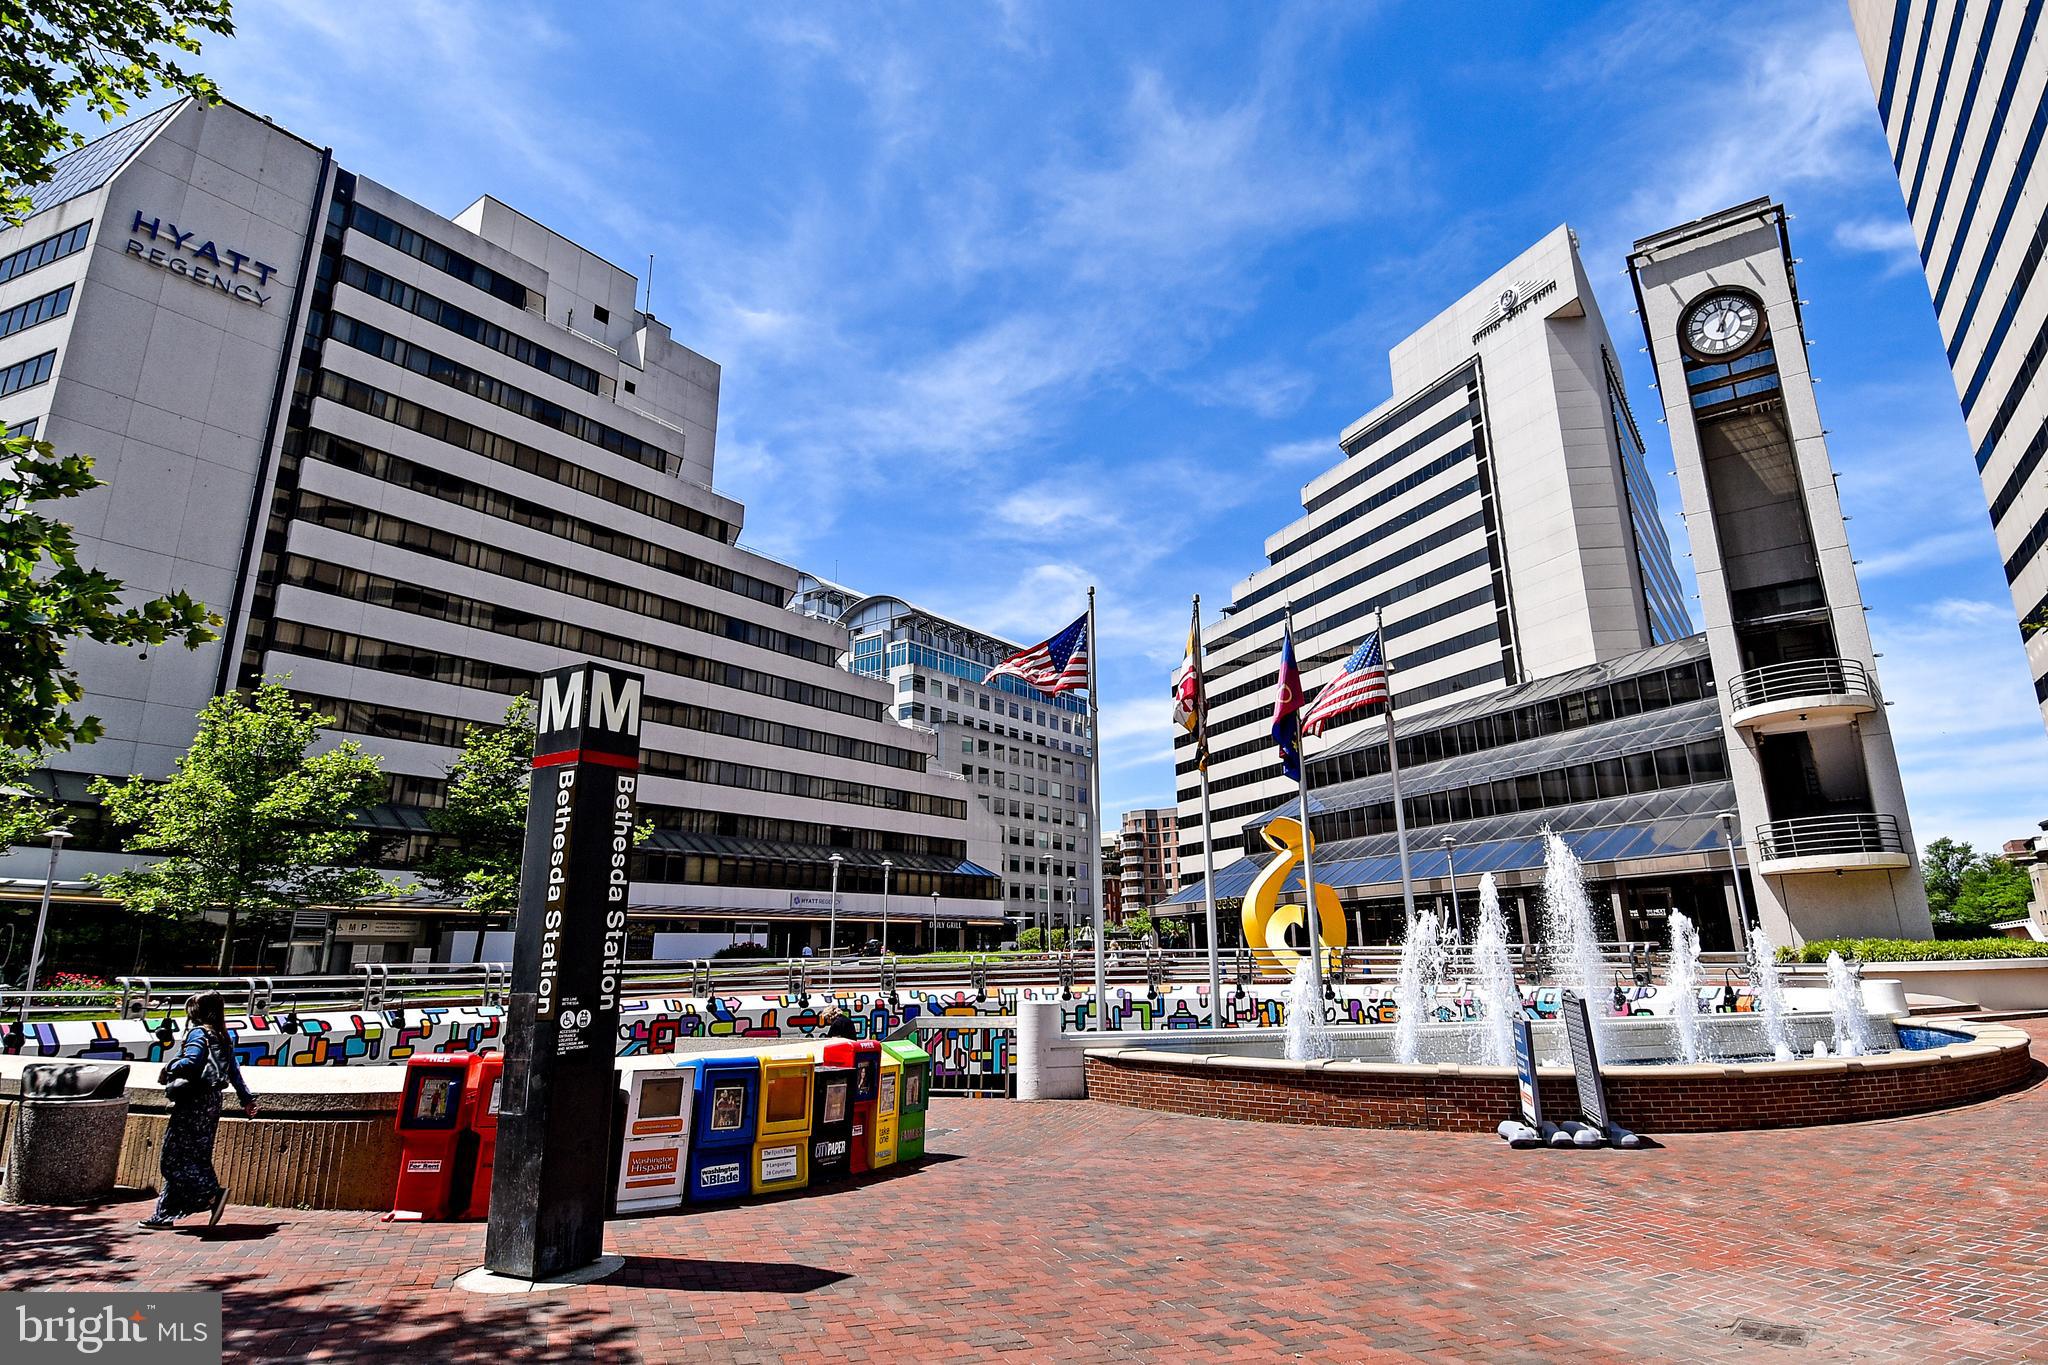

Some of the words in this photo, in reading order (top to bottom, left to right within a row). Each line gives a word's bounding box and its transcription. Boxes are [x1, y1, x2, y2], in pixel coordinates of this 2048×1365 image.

[132, 209, 278, 287] HYATT
[126, 238, 272, 308] REGENCY
[539, 670, 584, 735] M
[589, 669, 642, 737] M
[547, 769, 576, 902] Bethesda
[608, 775, 636, 902] Bethesda
[819, 898, 841, 906] REGECY
[360, 923, 368, 931] P
[946, 921, 962, 929] GRILL
[537, 910, 562, 1014] Station
[599, 910, 625, 1011] Station
[879, 1136, 889, 1145] one
[630, 1162, 673, 1173] Hispanic
[631, 1156, 674, 1166] Washington
[701, 1165, 739, 1176] washington
[709, 1172, 739, 1185] Blade
